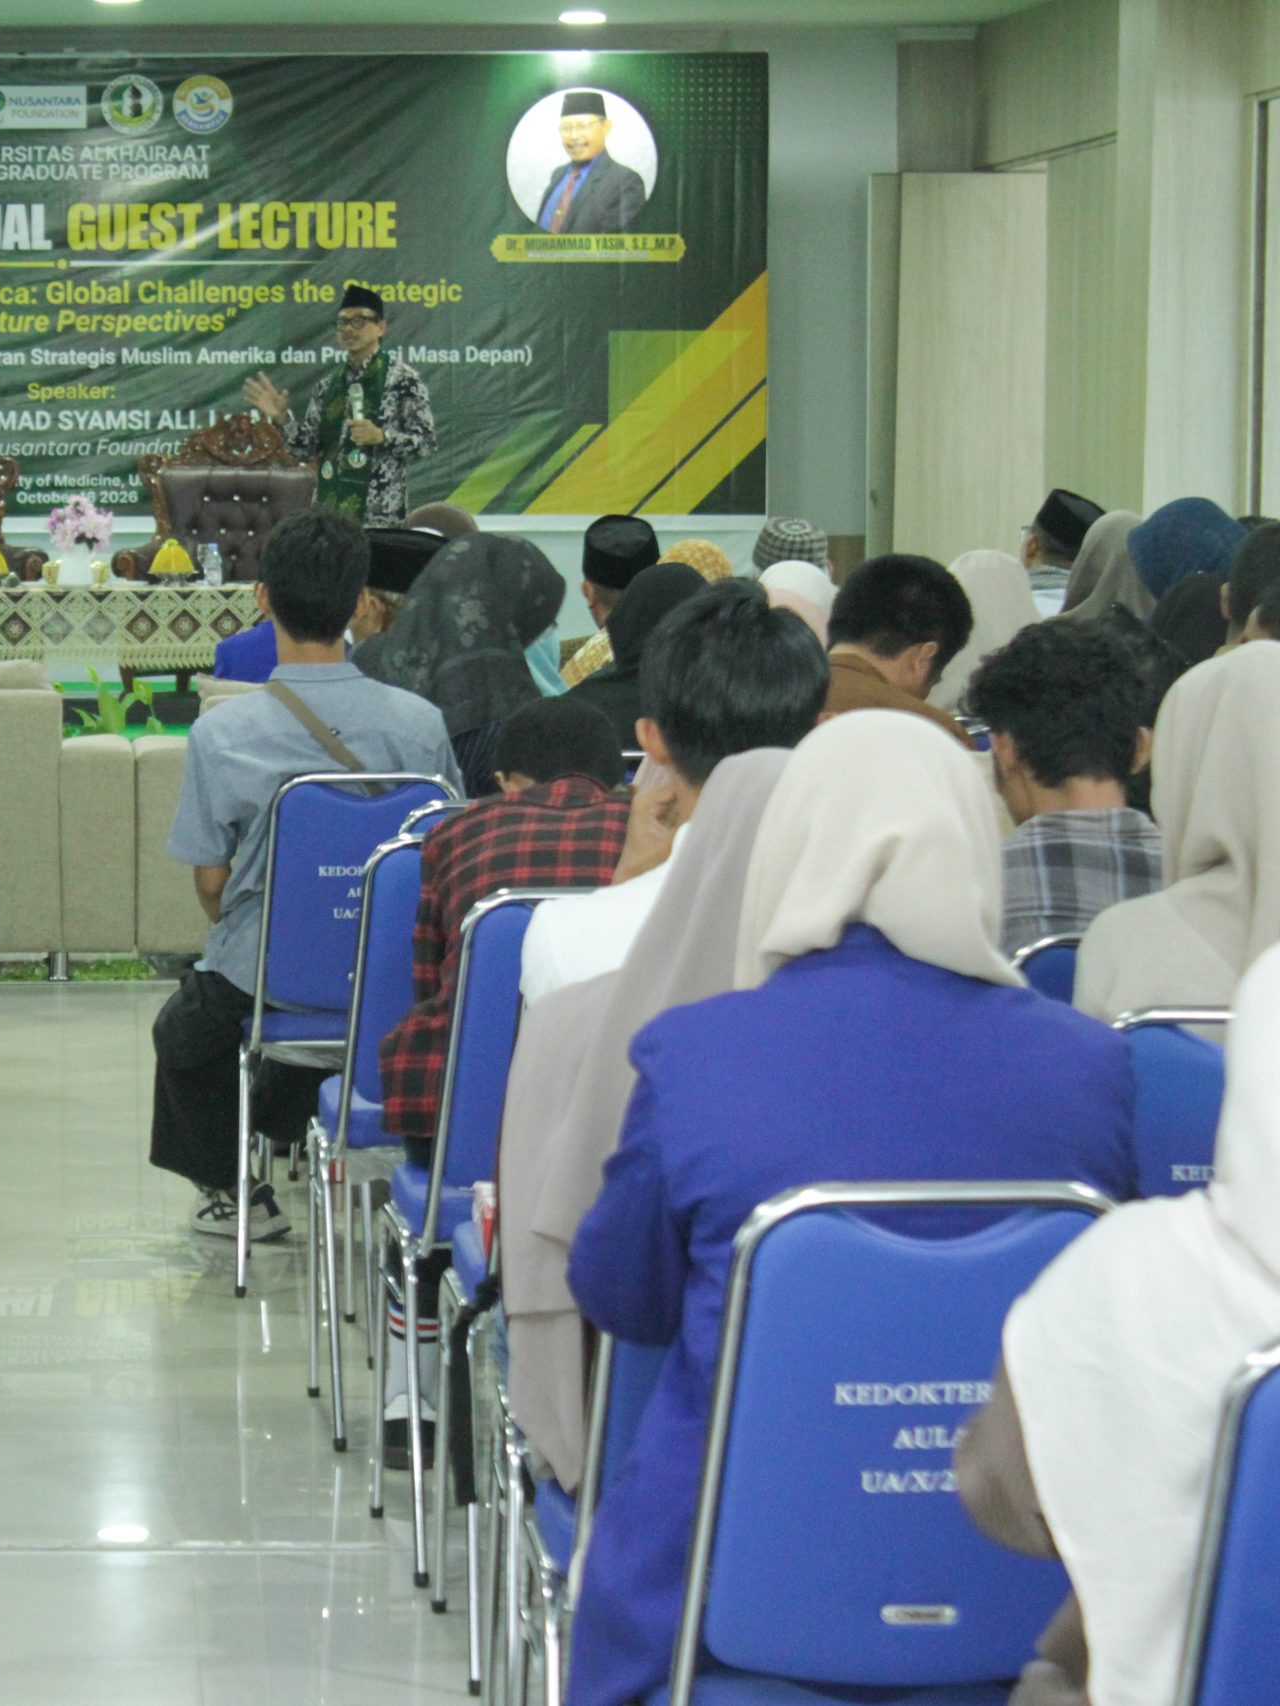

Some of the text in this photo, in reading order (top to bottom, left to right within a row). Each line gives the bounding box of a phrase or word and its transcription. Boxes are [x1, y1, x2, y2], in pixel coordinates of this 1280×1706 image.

[9, 96, 81, 107] NUSANTARA
[11, 109, 80, 119] FOUNDATION
[79, 145, 211, 162] ALKHAIRAAT
[108, 164, 210, 181] PROGRAM
[67, 202, 203, 252] GUEST
[218, 200, 397, 250] LECTURE
[525, 238, 592, 250] MUHAMMAD
[46, 280, 130, 305] Global
[138, 279, 286, 309] Challenges
[292, 280, 335, 303] the
[56, 308, 236, 337] Perspectives"
[30, 347, 116, 369] Strategis
[121, 347, 192, 364] Muslim
[196, 347, 276, 364] Amerika
[280, 347, 317, 364] dan
[408, 346, 460, 363] Masa
[464, 347, 533, 367] Depan)
[27, 383, 116, 402] Speaker:
[57, 409, 151, 431] SYAMSI
[35, 473, 52, 487] of
[54, 473, 126, 489] Medicine,
[100, 490, 139, 504] 2026
